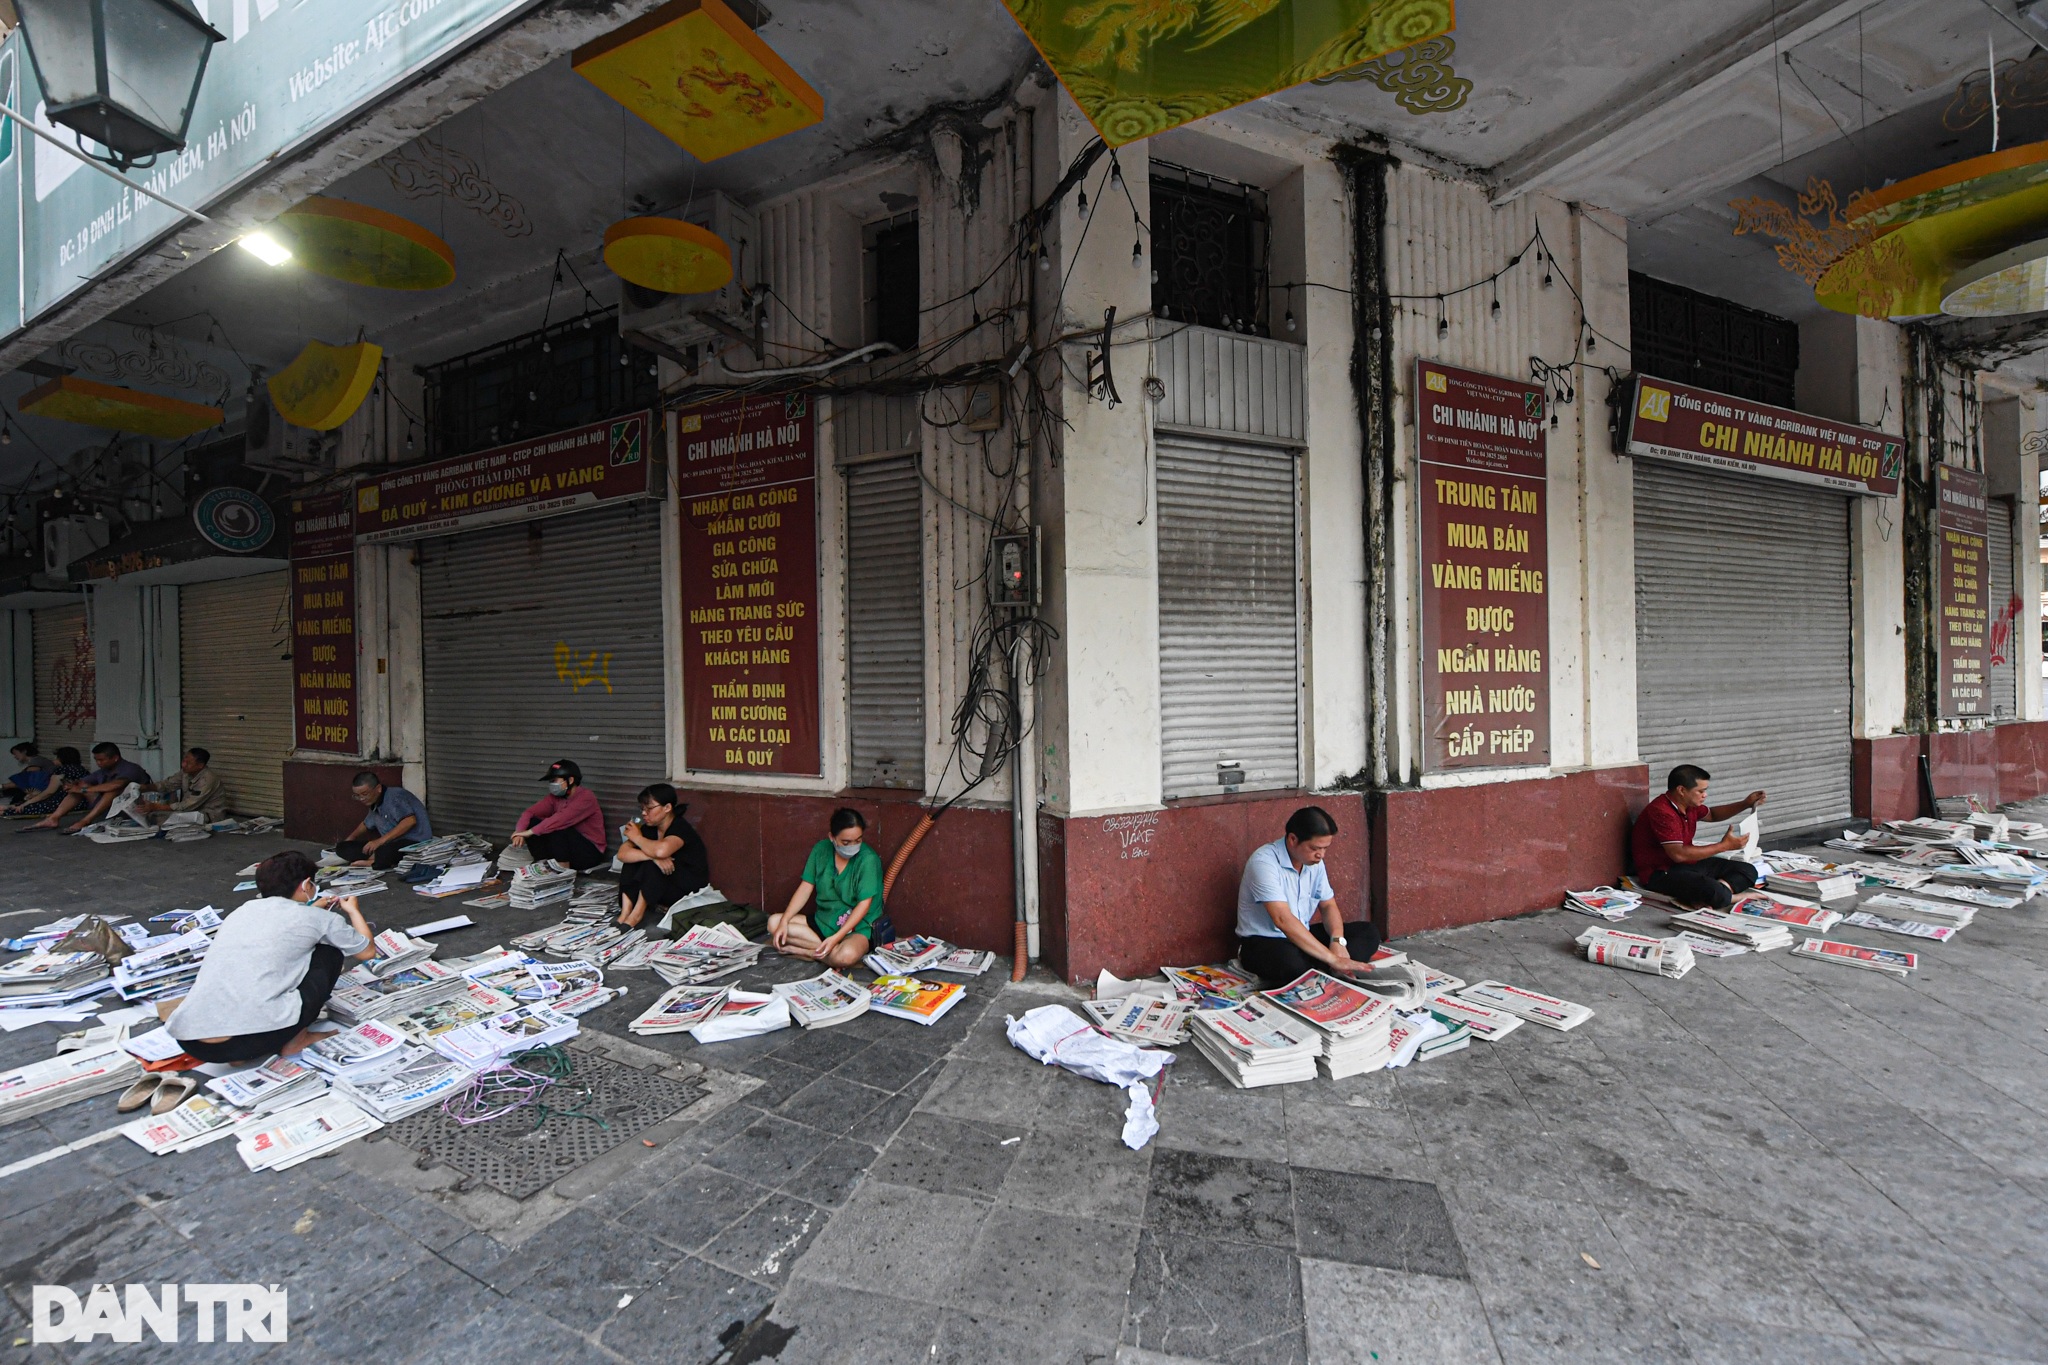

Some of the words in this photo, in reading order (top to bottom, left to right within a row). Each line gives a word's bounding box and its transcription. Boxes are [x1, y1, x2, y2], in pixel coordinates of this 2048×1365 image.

[289, 39, 360, 102] Website:
[77, 226, 89, 255] 19
[208, 120, 228, 161] HÀ
[231, 101, 256, 145] NỘI
[1432, 404, 1453, 427] CHI
[1456, 408, 1497, 434] NHÁNH
[1501, 414, 1516, 438] HÀ
[1519, 418, 1538, 444] NỘI
[1673, 393, 1701, 411] TỔNG
[1704, 402, 1731, 418] CÔNG
[1734, 409, 1746, 420] TY
[1748, 411, 1773, 427] VÀNG
[1774, 419, 1818, 437] AGRIBANK
[1820, 428, 1837, 442] VIỆT
[1838, 433, 1856, 446] NAM
[1862, 438, 1881, 451] CTCP
[440, 463, 473, 478] AGRIBANK
[490, 454, 507, 467] NAM
[513, 449, 532, 462] CTCP
[533, 444, 547, 457] CHI
[547, 436, 577, 453] NHÁNH
[577, 432, 589, 448] HÀ
[590, 428, 605, 444] NỘI
[688, 441, 707, 461] CHI
[711, 432, 753, 457] NHÁNH
[756, 425, 774, 449] HÀ
[777, 420, 800, 447] NỘI
[1700, 421, 1739, 453] CHI
[1743, 429, 1815, 467] NHÁNH
[1818, 444, 1842, 472] HÀ
[1847, 450, 1878, 482] NỘI
[435, 479, 469, 495] PHÒNG
[504, 464, 531, 482] ĐỊNH
[381, 505, 399, 523] ĐÁ
[402, 498, 427, 519] QUÝ
[441, 492, 469, 512] KIM
[472, 481, 526, 507] CƯƠNG
[530, 473, 553, 495] VÀ
[556, 464, 605, 490] VÀNG
[693, 497, 729, 517] NHẬN
[732, 494, 755, 511] GIA
[759, 487, 798, 507] CÔNG
[1435, 479, 1496, 509] TRUNG
[1501, 484, 1537, 514] TÂM
[749, 511, 781, 531] CƯỚI
[713, 541, 735, 557] GIA
[739, 536, 777, 554] CÔNG
[1447, 522, 1488, 549] MUA
[1493, 524, 1528, 553] BÁN
[298, 565, 326, 584] TRUNG
[328, 561, 349, 580] TÂM
[712, 559, 738, 578] SỬA
[742, 557, 779, 576] CHỮA
[1432, 559, 1482, 590] VÀNG
[1487, 562, 1543, 593] MIẾNG
[303, 593, 323, 610] MUA
[716, 583, 744, 600] LÀM
[748, 579, 775, 597] MỚI
[322, 613, 353, 635] MIẾNG
[690, 606, 725, 624] HÀNG
[729, 604, 773, 621] TRANG
[777, 600, 805, 618] SỨC
[1466, 606, 1514, 637] ĐƯỢC
[701, 629, 733, 645] THEO
[736, 625, 761, 642] YÊU
[766, 621, 794, 641] CẦU
[704, 648, 749, 666] KHÁCH
[752, 646, 790, 664] HÀNG
[1438, 643, 1489, 673] NGÂN
[1495, 644, 1540, 672] HÀNG
[327, 669, 352, 689] HÀNG
[711, 679, 749, 698] THẨM
[752, 684, 786, 701] ĐỊNH
[304, 696, 321, 714] NHÀ
[324, 696, 349, 716] NƯỚC
[711, 706, 737, 720] KIM
[741, 704, 787, 721] CƯƠNG
[1446, 685, 1484, 715] NHÀ
[1489, 684, 1535, 713] NƯỚC
[325, 723, 349, 743] PHÉP
[709, 725, 726, 741] VÀ
[729, 725, 756, 742] CÁC
[760, 729, 791, 746] LOẠI
[1448, 723, 1485, 757] CẤP
[1490, 725, 1535, 754] PHÉP
[725, 747, 743, 764] ĐÁ
[747, 748, 774, 766] QUÝ
